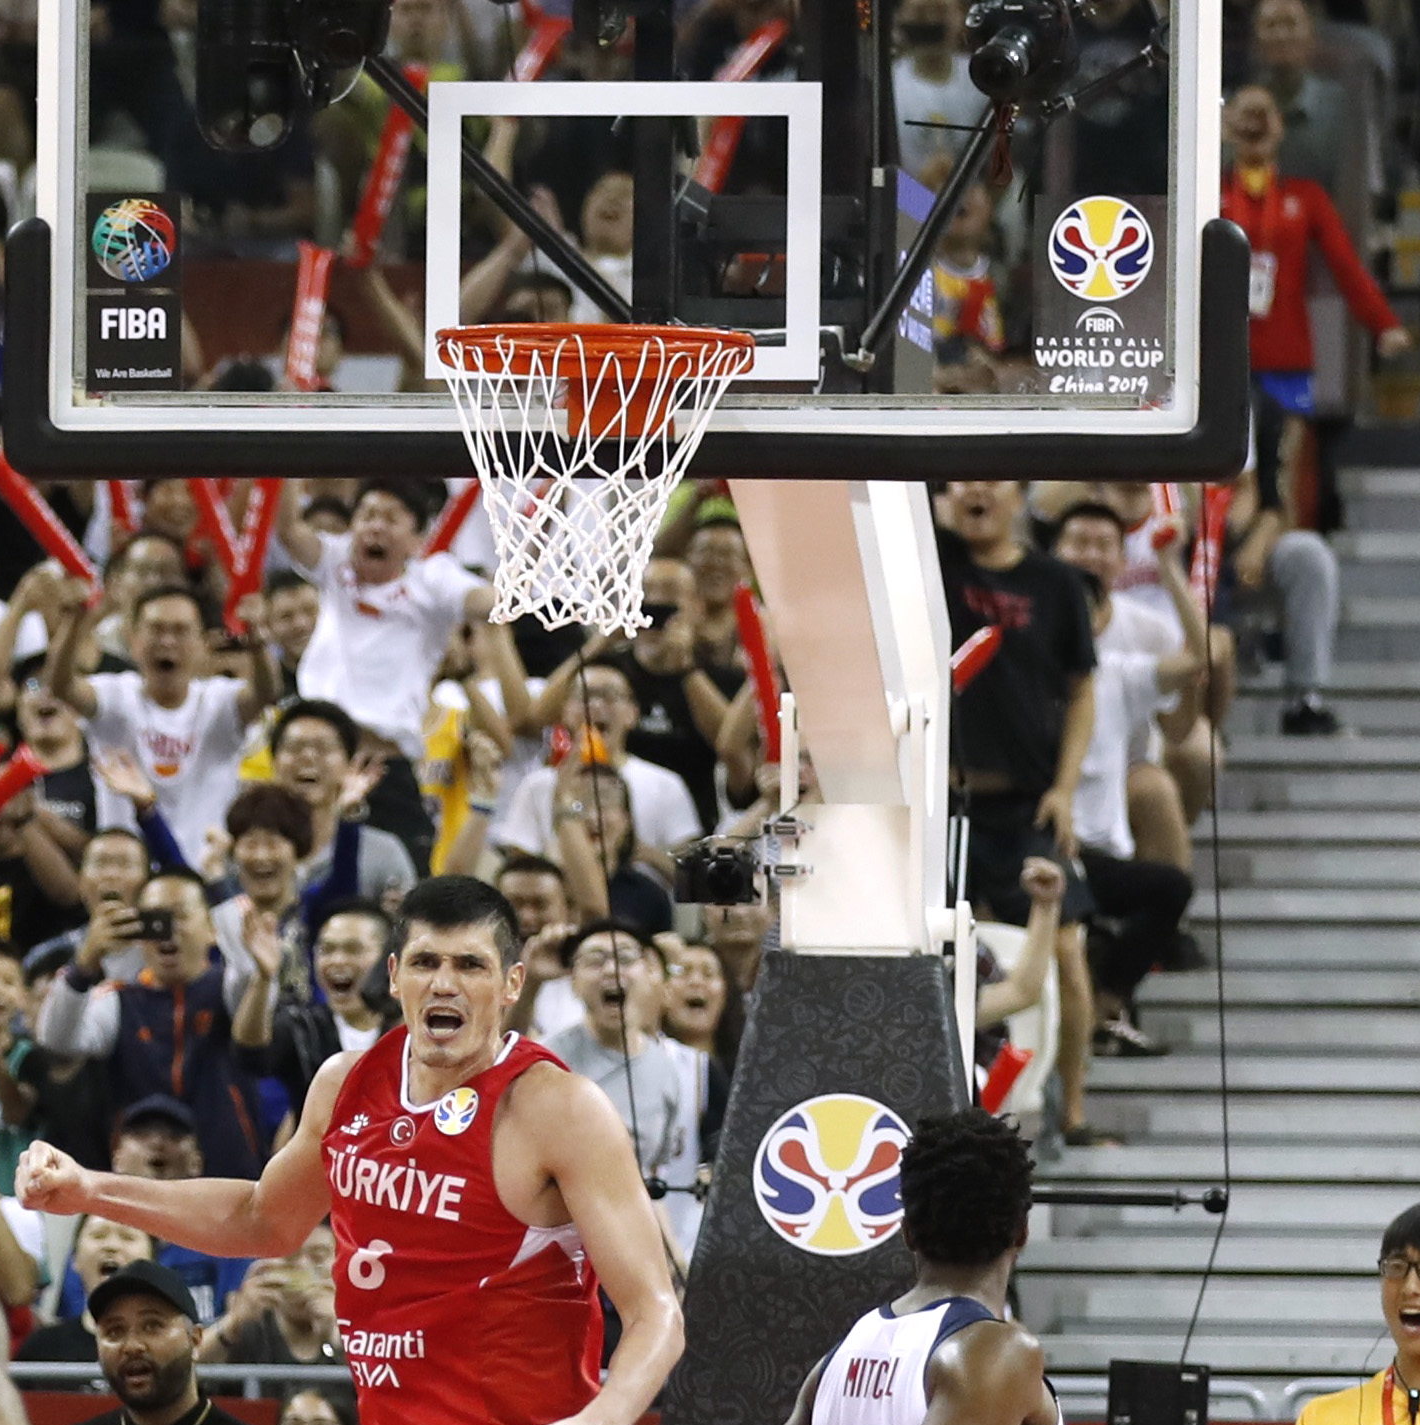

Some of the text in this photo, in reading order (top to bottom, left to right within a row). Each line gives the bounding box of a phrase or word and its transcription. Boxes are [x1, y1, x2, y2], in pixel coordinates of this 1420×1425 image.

[101, 307, 167, 340] FIBA
[1085, 317, 1115, 333] FIBA
[1035, 337, 1161, 348] BASKETBALL
[1034, 349, 1165, 368] WORLD CUP
[129, 368, 172, 378] Basketball
[1049, 375, 1149, 395] China 2019
